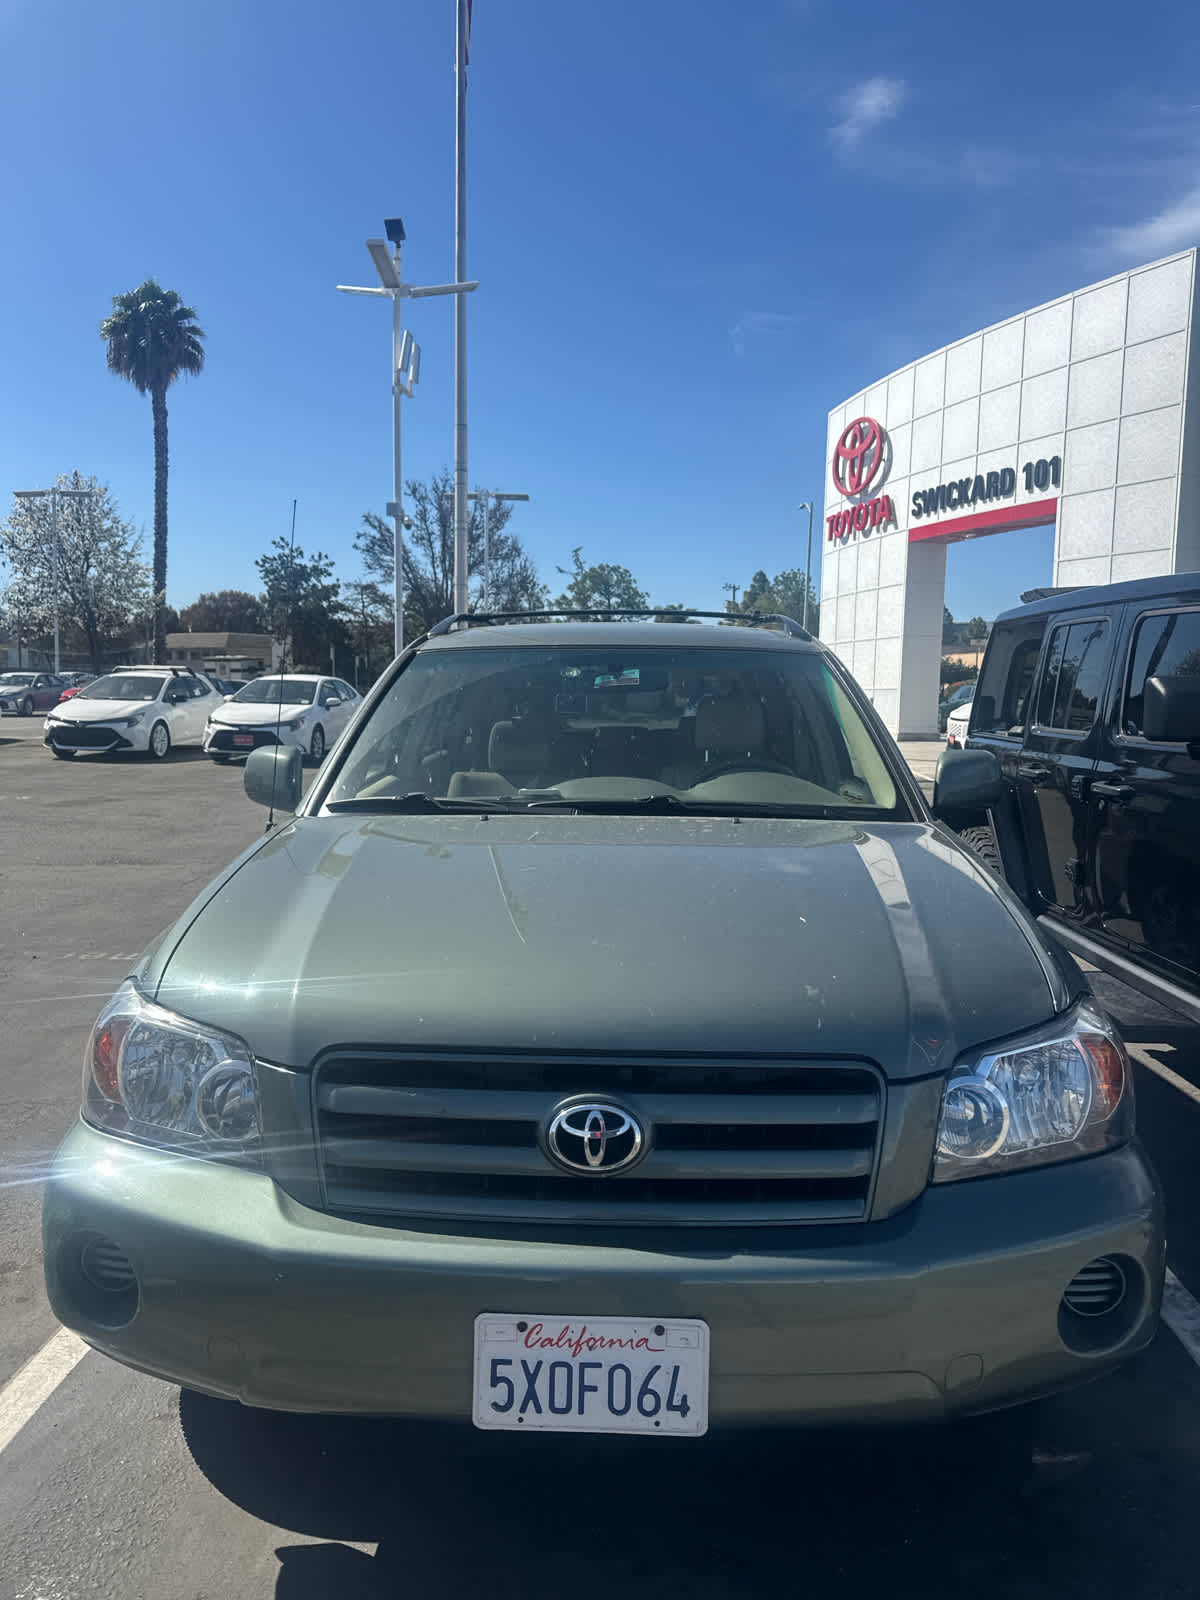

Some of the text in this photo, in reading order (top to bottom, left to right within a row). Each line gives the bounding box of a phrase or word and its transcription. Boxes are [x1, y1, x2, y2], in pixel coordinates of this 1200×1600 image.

[911, 456, 1062, 519] SWICKARD 101
[826, 495, 892, 541] TOYOTA
[523, 1323, 665, 1357] California
